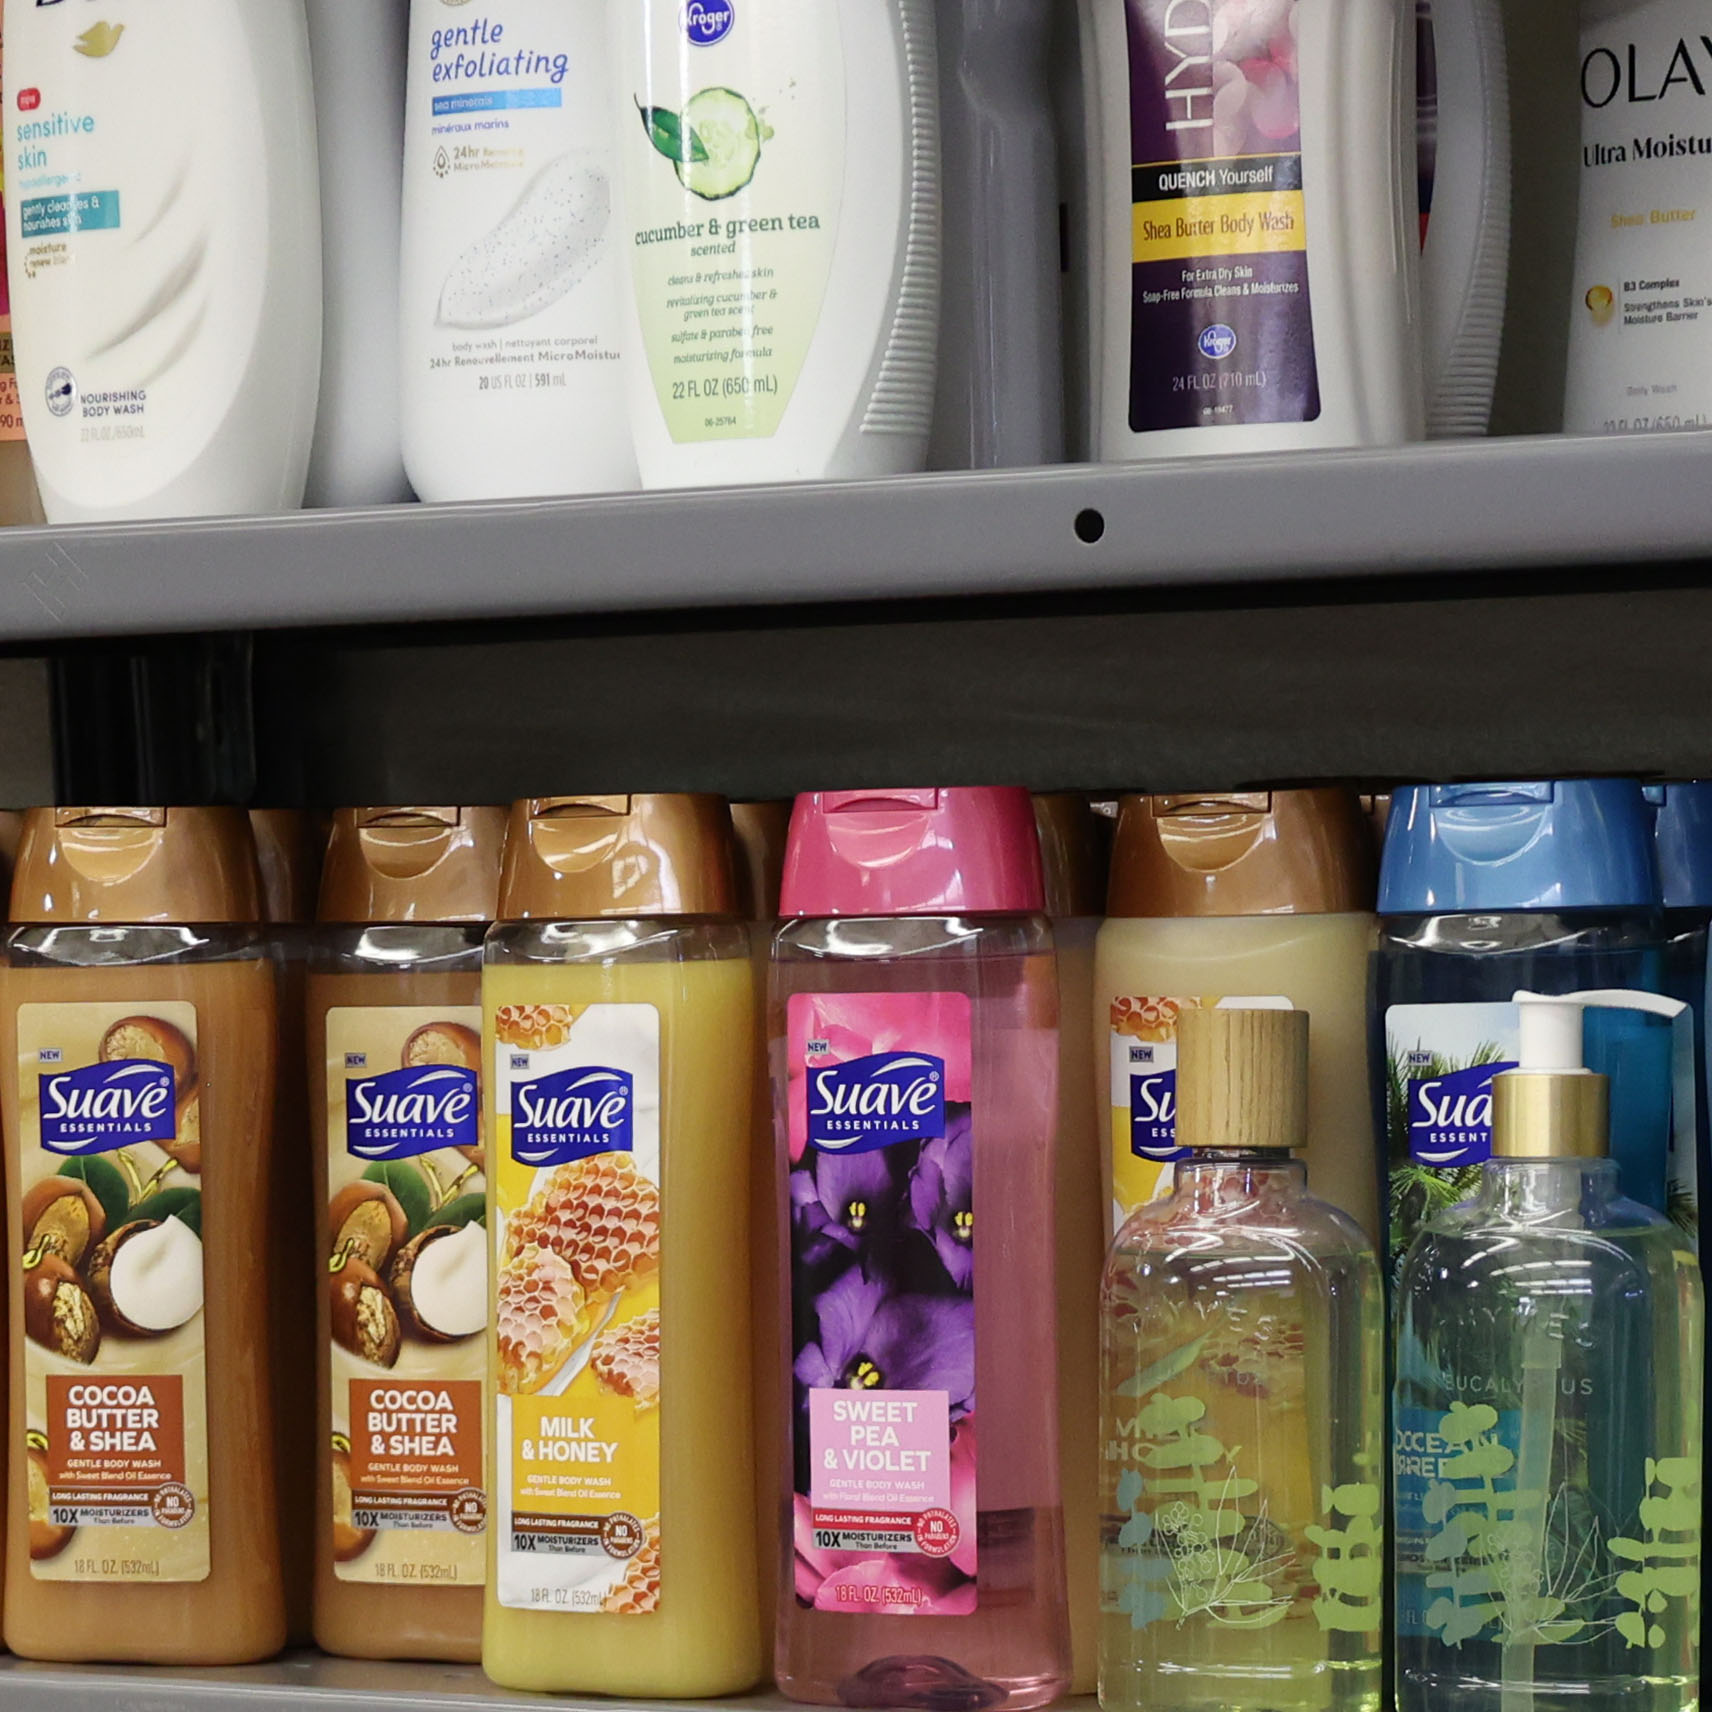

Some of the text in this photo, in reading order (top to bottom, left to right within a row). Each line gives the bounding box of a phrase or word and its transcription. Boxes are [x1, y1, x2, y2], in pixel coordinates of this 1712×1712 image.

[430, 18, 503, 60] gentle
[432, 49, 568, 84] exfoliating
[17, 112, 94, 142] sensitive
[474, 118, 509, 131] marins
[18, 145, 47, 170] skin
[454, 145, 480, 159] 24hr
[1159, 165, 1273, 192] QUENCH Yourself
[635, 213, 820, 246] cucumber green tea
[1144, 211, 1294, 241] Shea Body Wash
[691, 241, 736, 257] scented
[1182, 266, 1252, 282] For Extra Dry Skin
[80, 390, 146, 405] NOURISHING
[42, 1080, 168, 1122] Suave
[349, 1081, 471, 1125] Suave
[810, 1069, 937, 1117] Suave
[513, 1088, 627, 1129] Suave
[69, 1385, 154, 1406] COCOA
[370, 1389, 453, 1412] COCOA
[66, 1408, 159, 1429] BUTTER
[833, 1400, 918, 1423] SWEET
[368, 1412, 457, 1435] BUTTER
[540, 1416, 596, 1439] MILK
[90, 1431, 157, 1452] SHEA
[387, 1434, 455, 1457] SHEA
[851, 1426, 899, 1447] PEA
[538, 1439, 618, 1464] HONEY
[843, 1450, 931, 1472] VIOLET
[103, 1493, 148, 1501] FRAGRANCE
[815, 1515, 911, 1525] LONG LASTING FRAGRANCE
